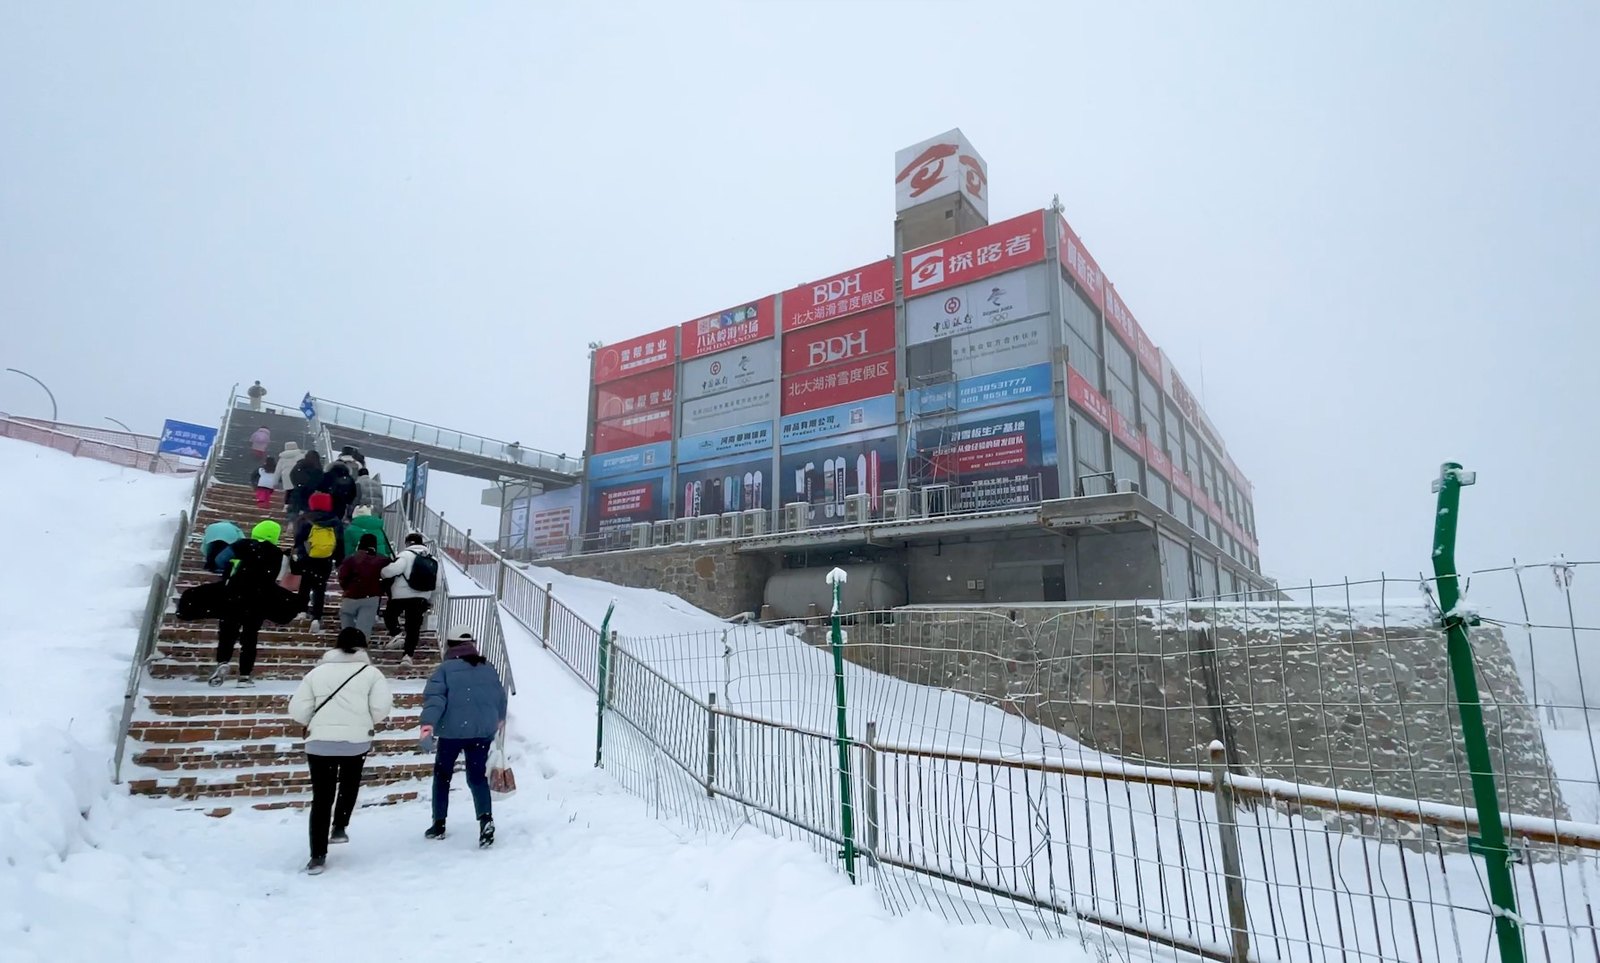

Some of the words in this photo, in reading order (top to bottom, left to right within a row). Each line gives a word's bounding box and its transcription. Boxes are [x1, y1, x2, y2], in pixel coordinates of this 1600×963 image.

[948, 233, 1031, 273] 探路者
[791, 288, 885, 326] 北大湖滑雪度假区
[812, 272, 862, 306] BDH
[733, 332, 758, 345] SNOW
[807, 329, 869, 367] BDH
[789, 361, 889, 396] 北大湖滑雪度假区
